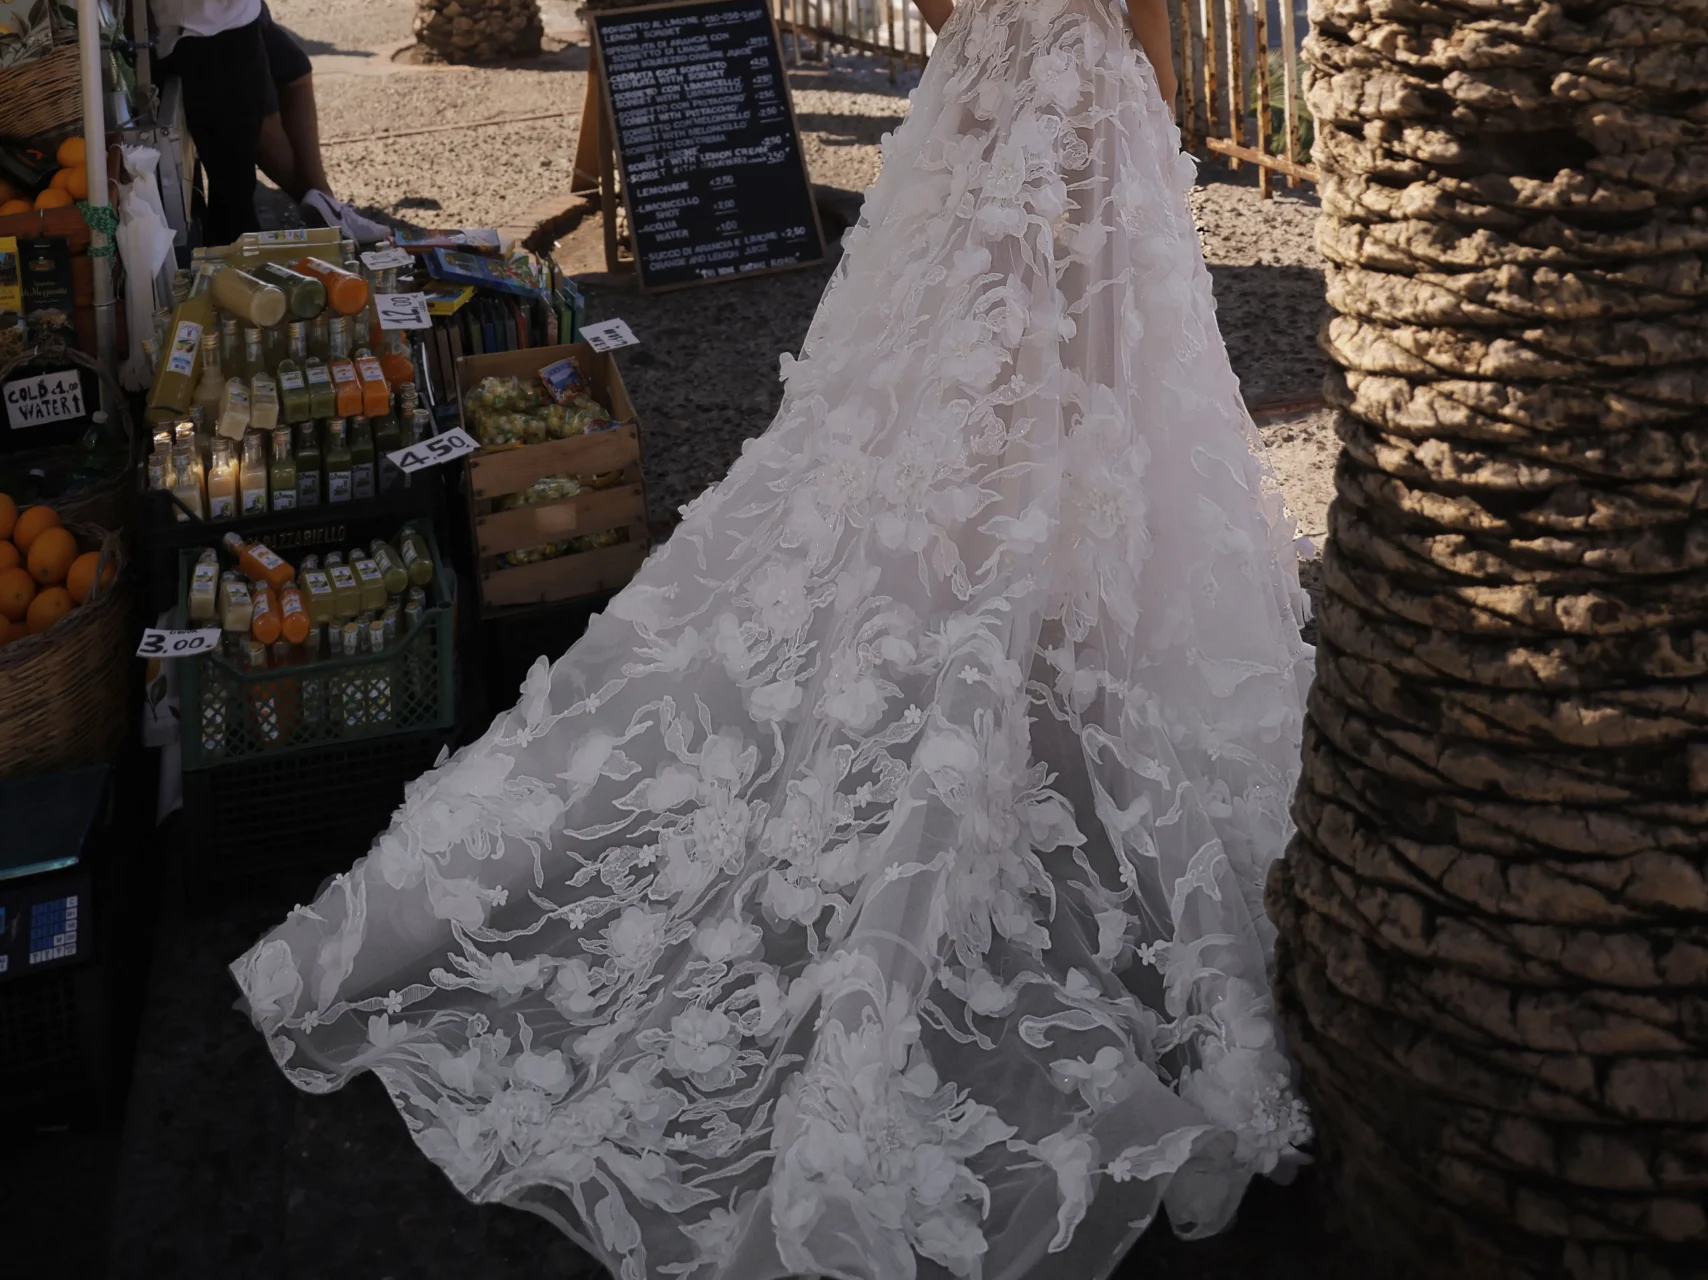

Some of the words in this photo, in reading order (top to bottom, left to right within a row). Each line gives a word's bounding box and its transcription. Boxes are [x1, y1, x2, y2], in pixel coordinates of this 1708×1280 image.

[636, 182, 688, 196] LEMONADE
[655, 209, 680, 218] SHOT
[655, 229, 688, 240] WATER
[8, 382, 48, 403] COLD
[19, 396, 71, 421] WATER
